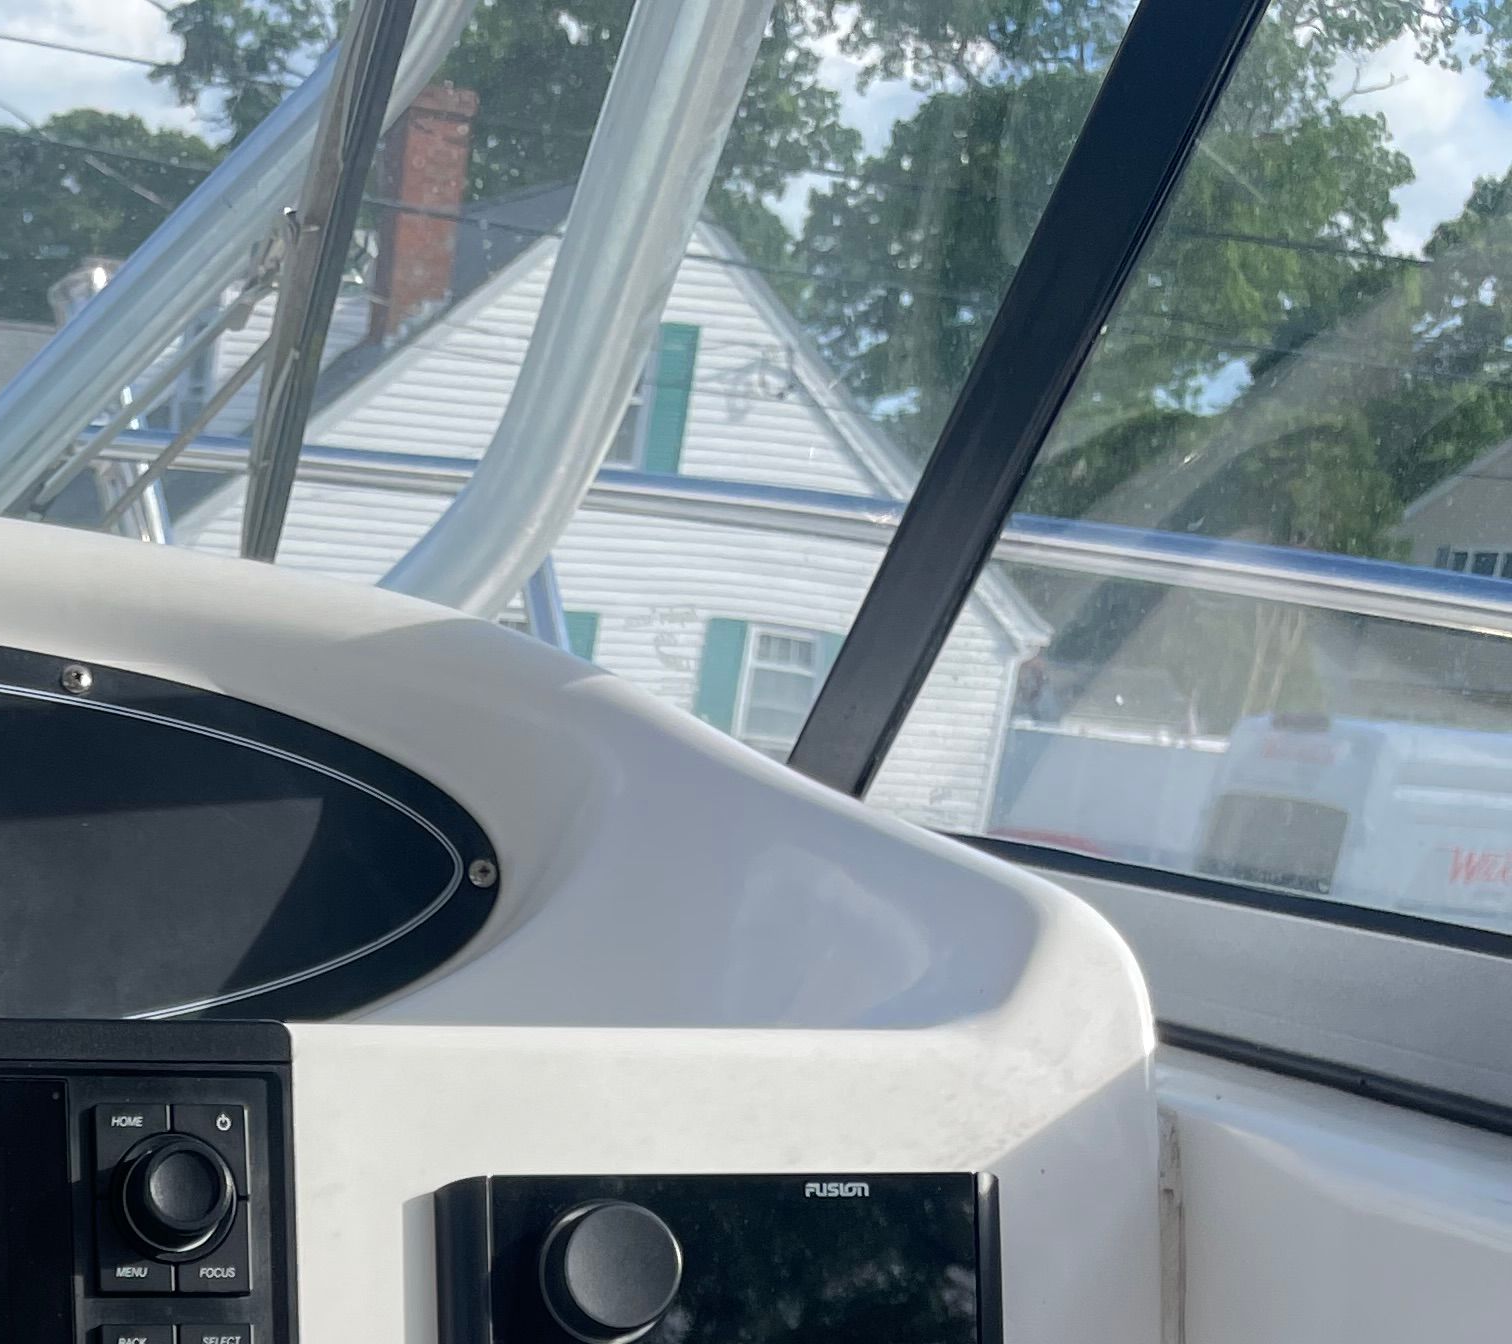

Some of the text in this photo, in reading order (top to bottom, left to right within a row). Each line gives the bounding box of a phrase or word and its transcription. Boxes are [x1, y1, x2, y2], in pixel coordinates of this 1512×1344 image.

[110, 1116, 143, 1128] HOME
[804, 1182, 870, 1198] FUSION
[116, 1267, 148, 1278] MENU
[199, 1267, 236, 1279] FOCUS
